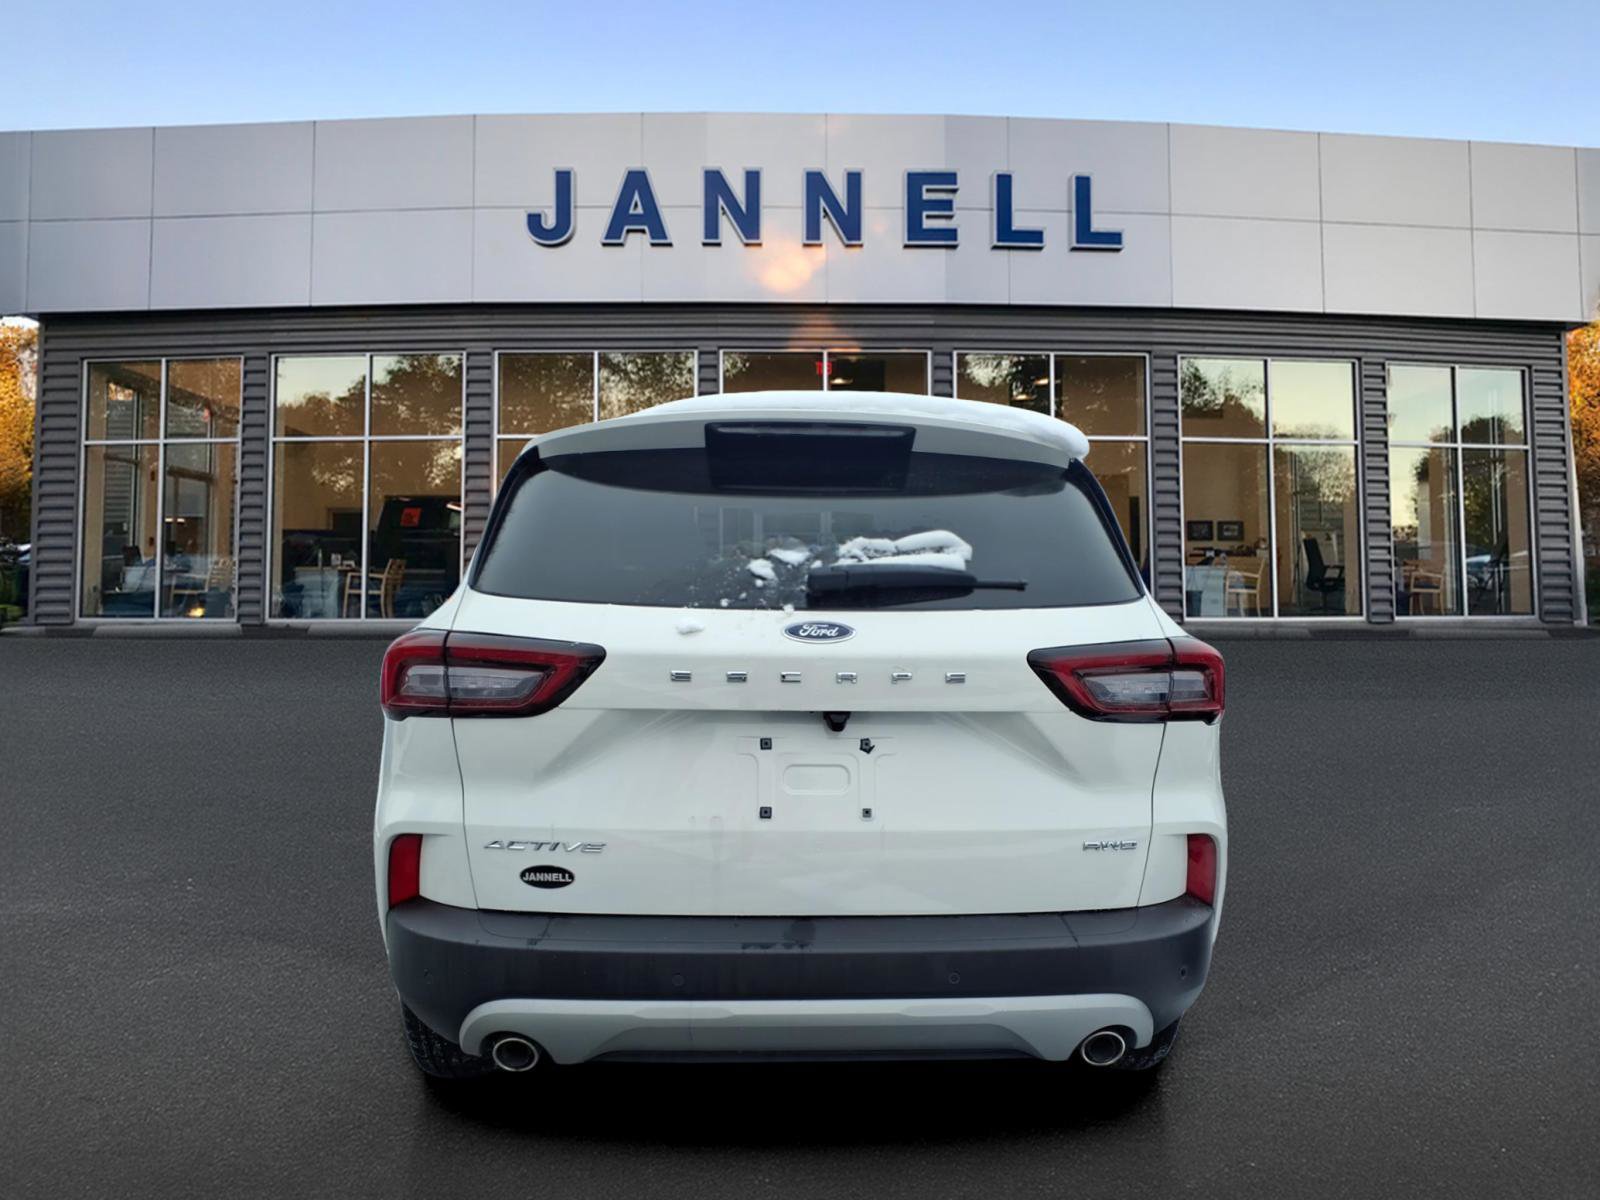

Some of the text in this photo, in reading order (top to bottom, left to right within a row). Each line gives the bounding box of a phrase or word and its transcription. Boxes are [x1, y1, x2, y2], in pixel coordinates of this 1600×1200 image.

[525, 167, 1123, 250] JANNELL
[799, 623, 840, 637] Ford
[670, 670, 966, 683] ESCAPE
[484, 840, 607, 853] ACTIVE
[522, 872, 573, 882] JANNELL
